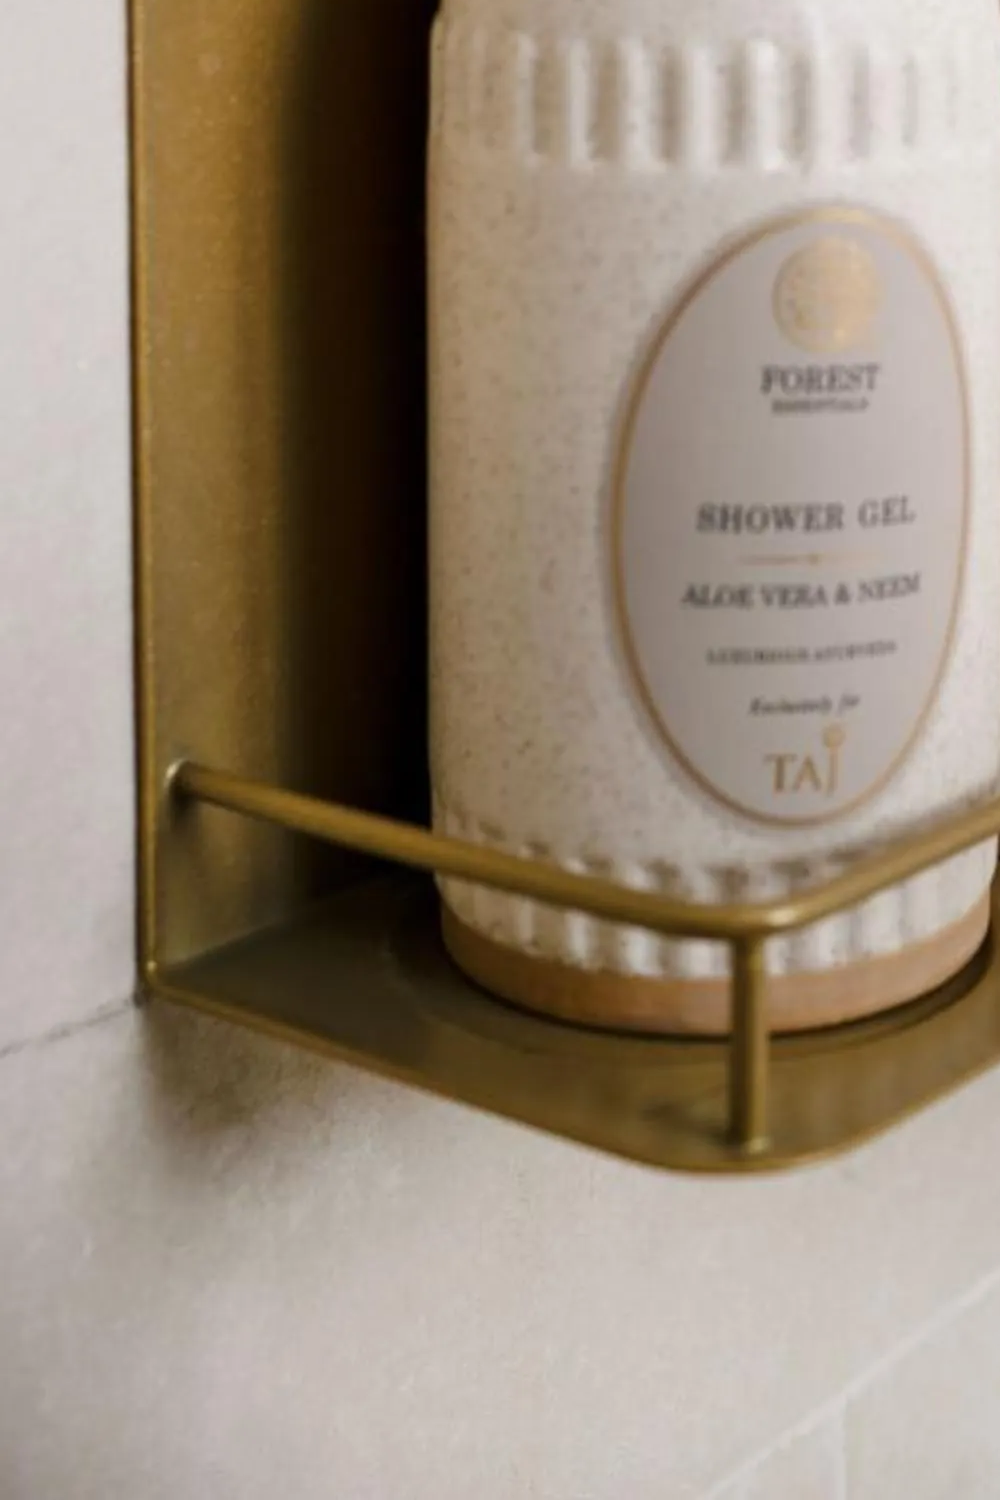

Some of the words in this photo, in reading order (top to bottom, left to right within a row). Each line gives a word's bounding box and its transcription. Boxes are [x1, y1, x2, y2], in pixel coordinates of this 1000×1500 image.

[760, 362, 881, 396] FOREST
[694, 500, 846, 535] SHOWER
[857, 494, 917, 529] GEL
[680, 581, 755, 610] ALOE
[759, 582, 829, 609] VERA
[833, 581, 853, 606] &
[857, 572, 921, 604] NEEM
